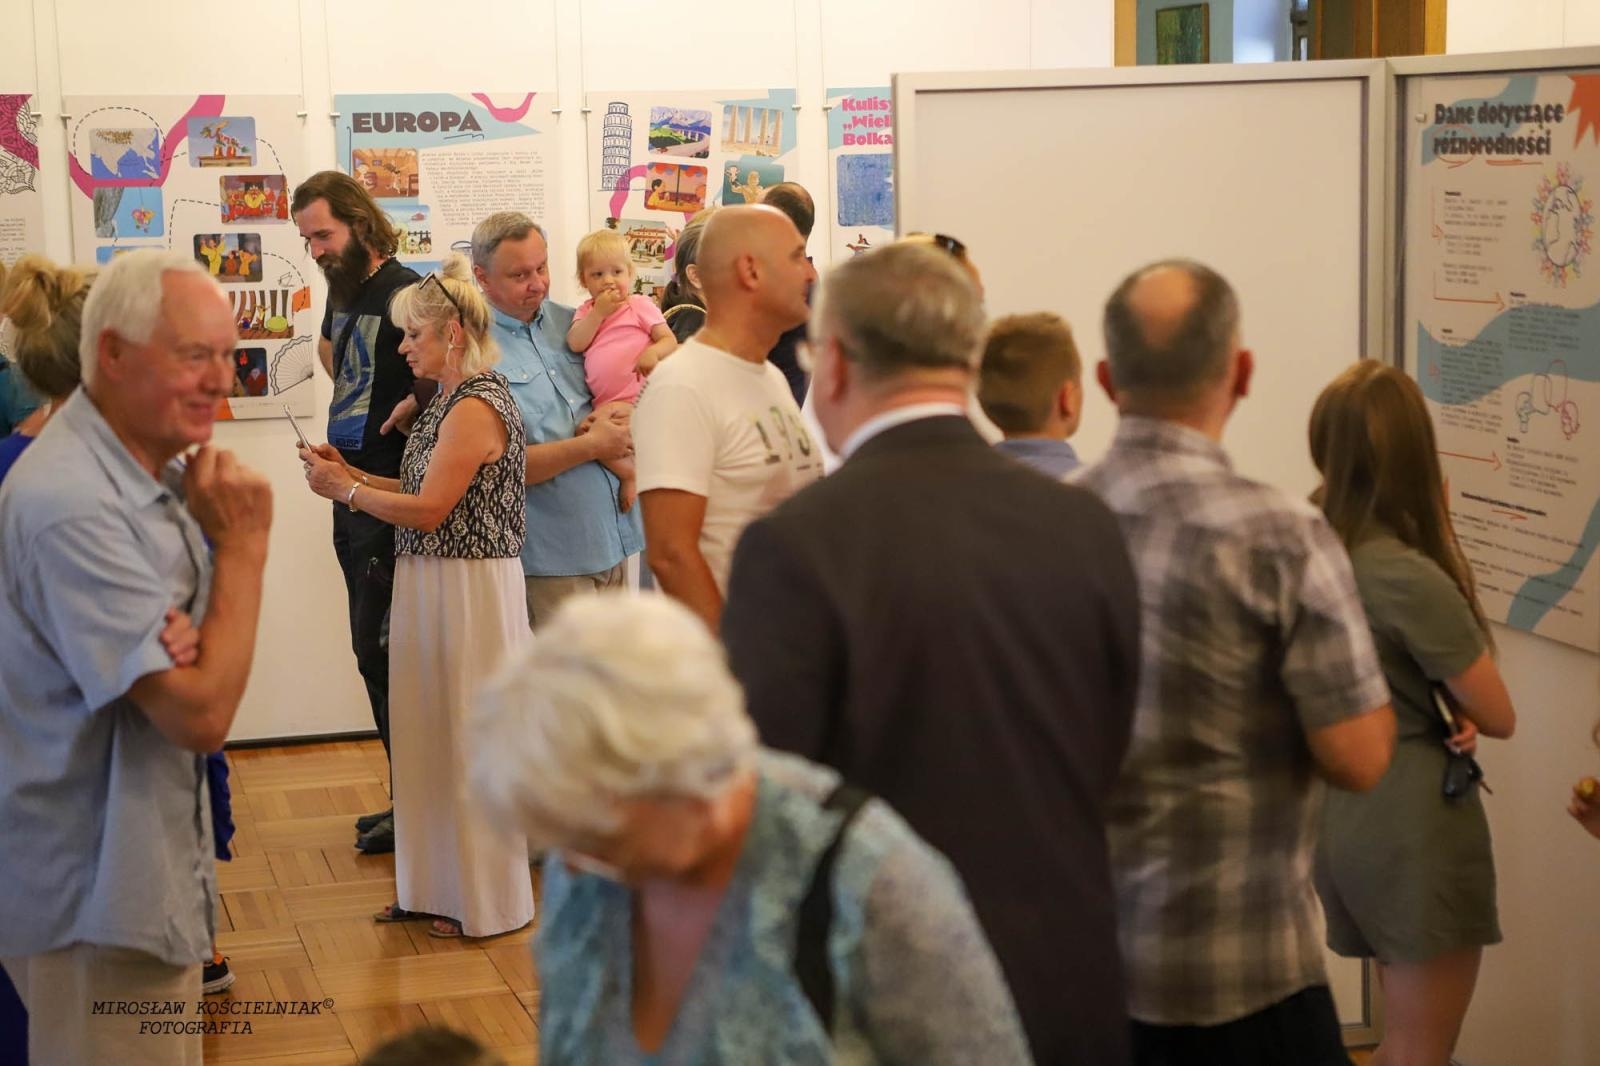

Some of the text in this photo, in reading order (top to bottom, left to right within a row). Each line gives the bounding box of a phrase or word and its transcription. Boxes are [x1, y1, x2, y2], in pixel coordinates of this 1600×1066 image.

[352, 109, 482, 133] EUROPA
[1434, 101, 1564, 130] Dane dotyczące
[843, 132, 894, 146] Bolka
[1433, 129, 1552, 155] różnorodności
